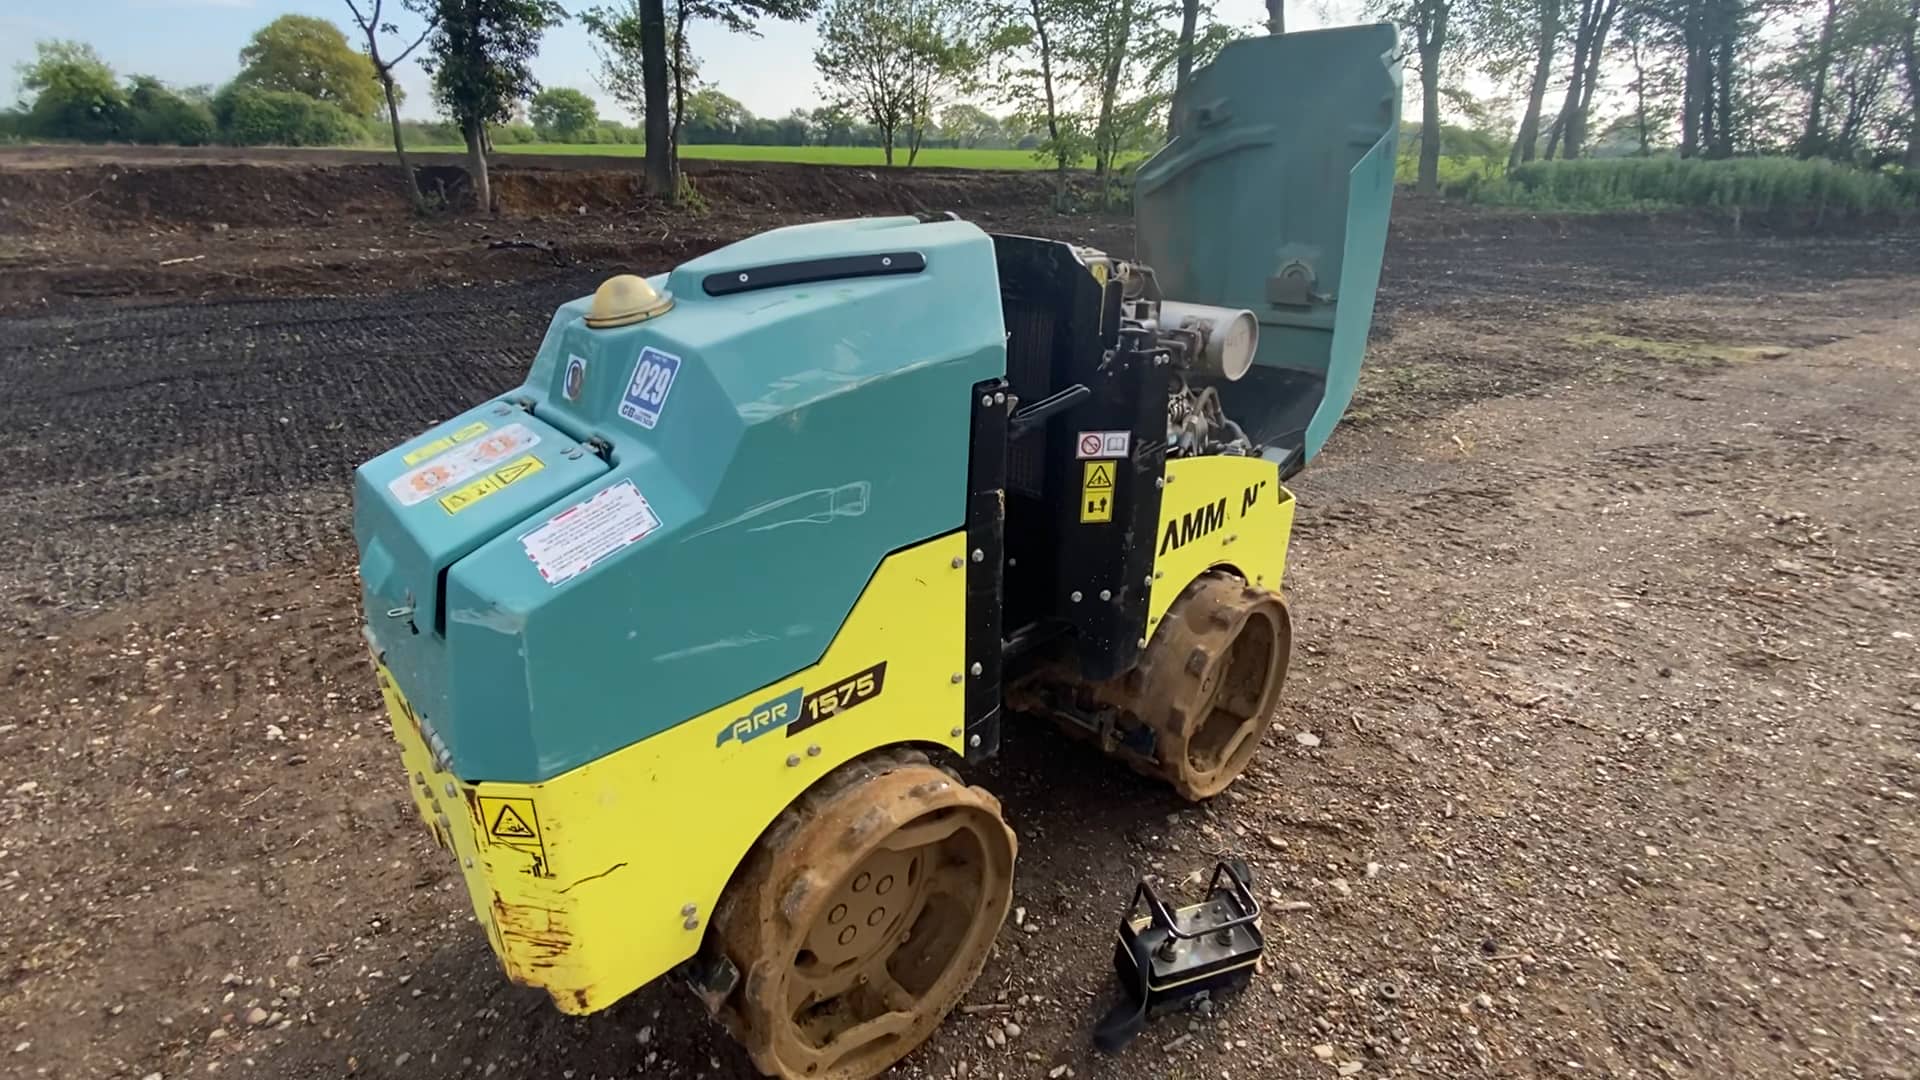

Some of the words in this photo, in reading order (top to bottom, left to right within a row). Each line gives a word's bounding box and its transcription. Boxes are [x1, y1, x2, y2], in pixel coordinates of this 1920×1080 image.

[631, 360, 671, 405] 929
[1159, 480, 1266, 557] AMMN
[732, 702, 788, 740] ARR
[808, 673, 875, 719] 1575
